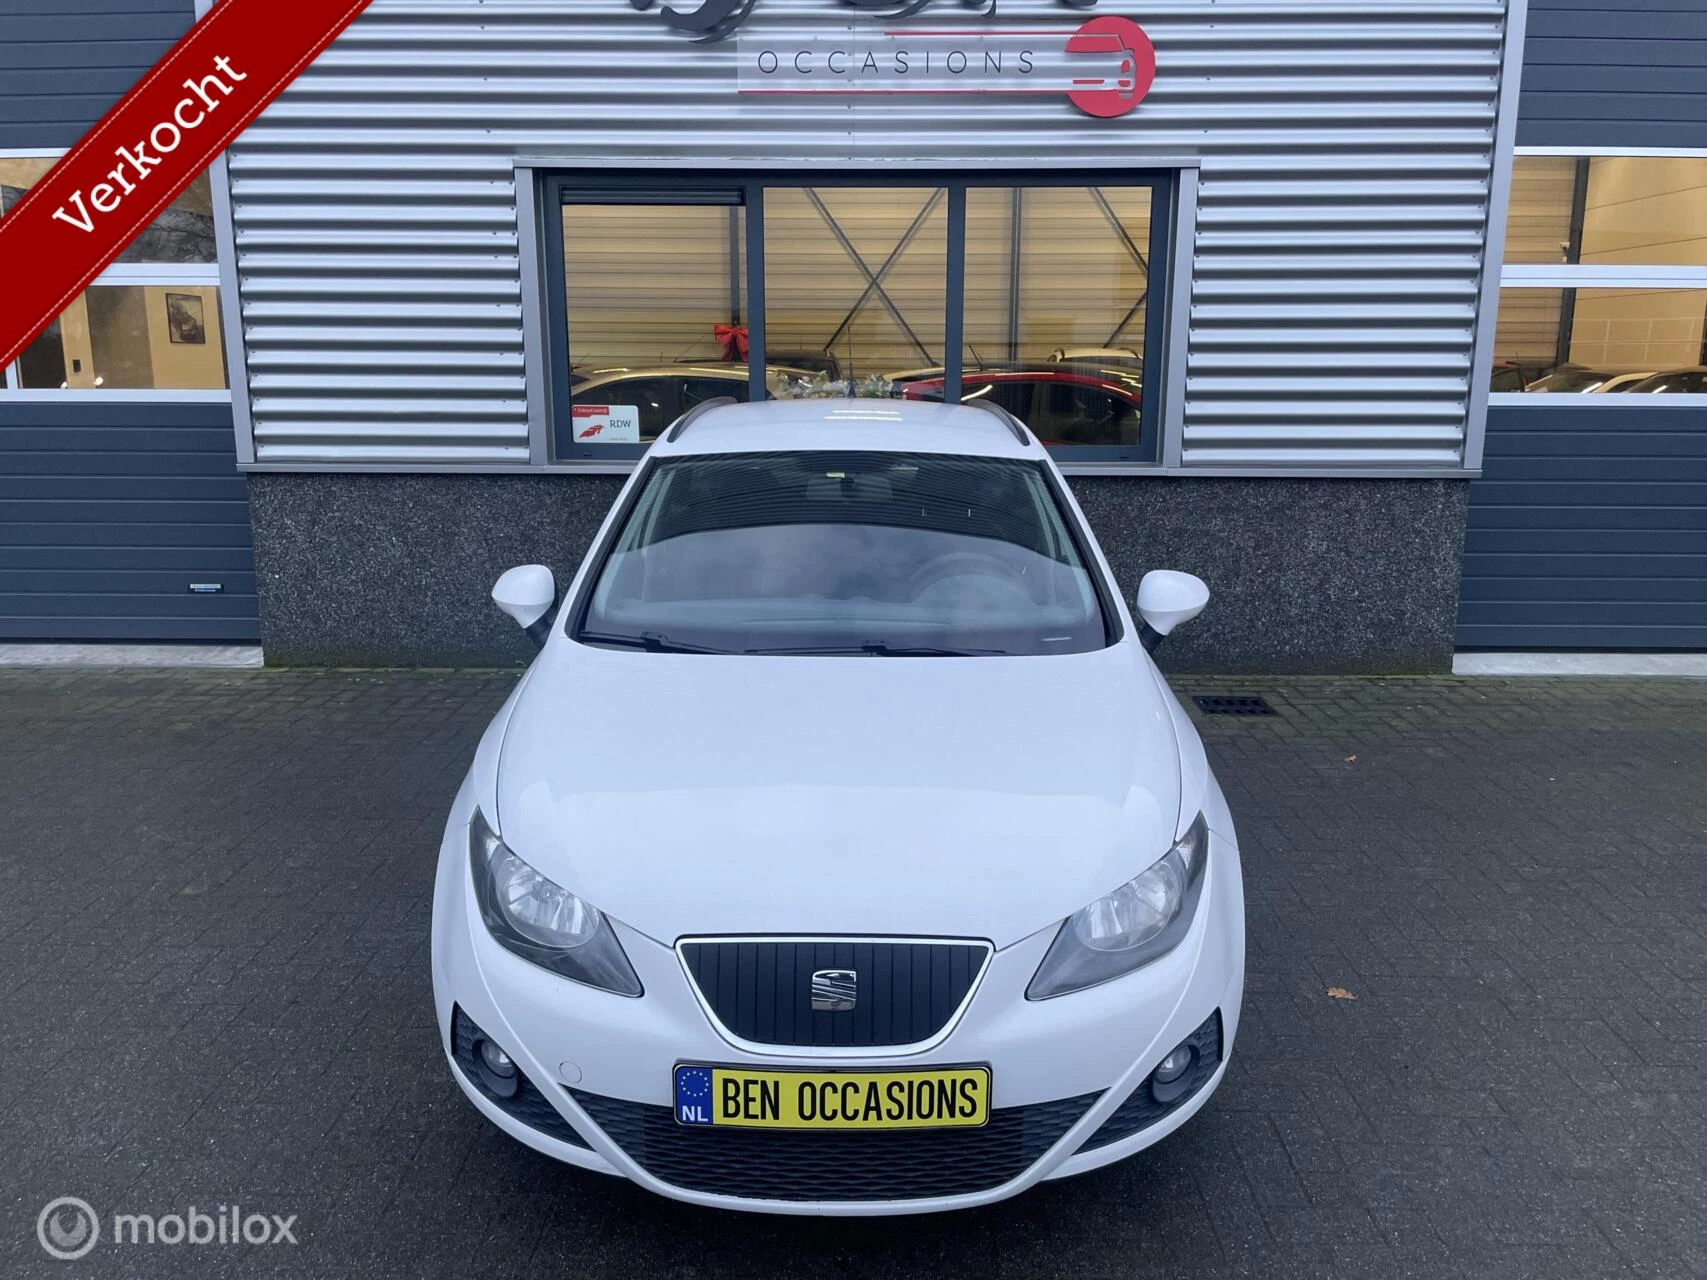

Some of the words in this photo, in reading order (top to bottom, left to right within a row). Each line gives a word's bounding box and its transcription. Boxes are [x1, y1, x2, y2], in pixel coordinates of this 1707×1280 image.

[757, 50, 1035, 75] OCCASIONS
[609, 420, 631, 428] RDW
[722, 1078, 780, 1120] BEN
[797, 1077, 978, 1120] OCCASIONS
[681, 1105, 709, 1123] NL
